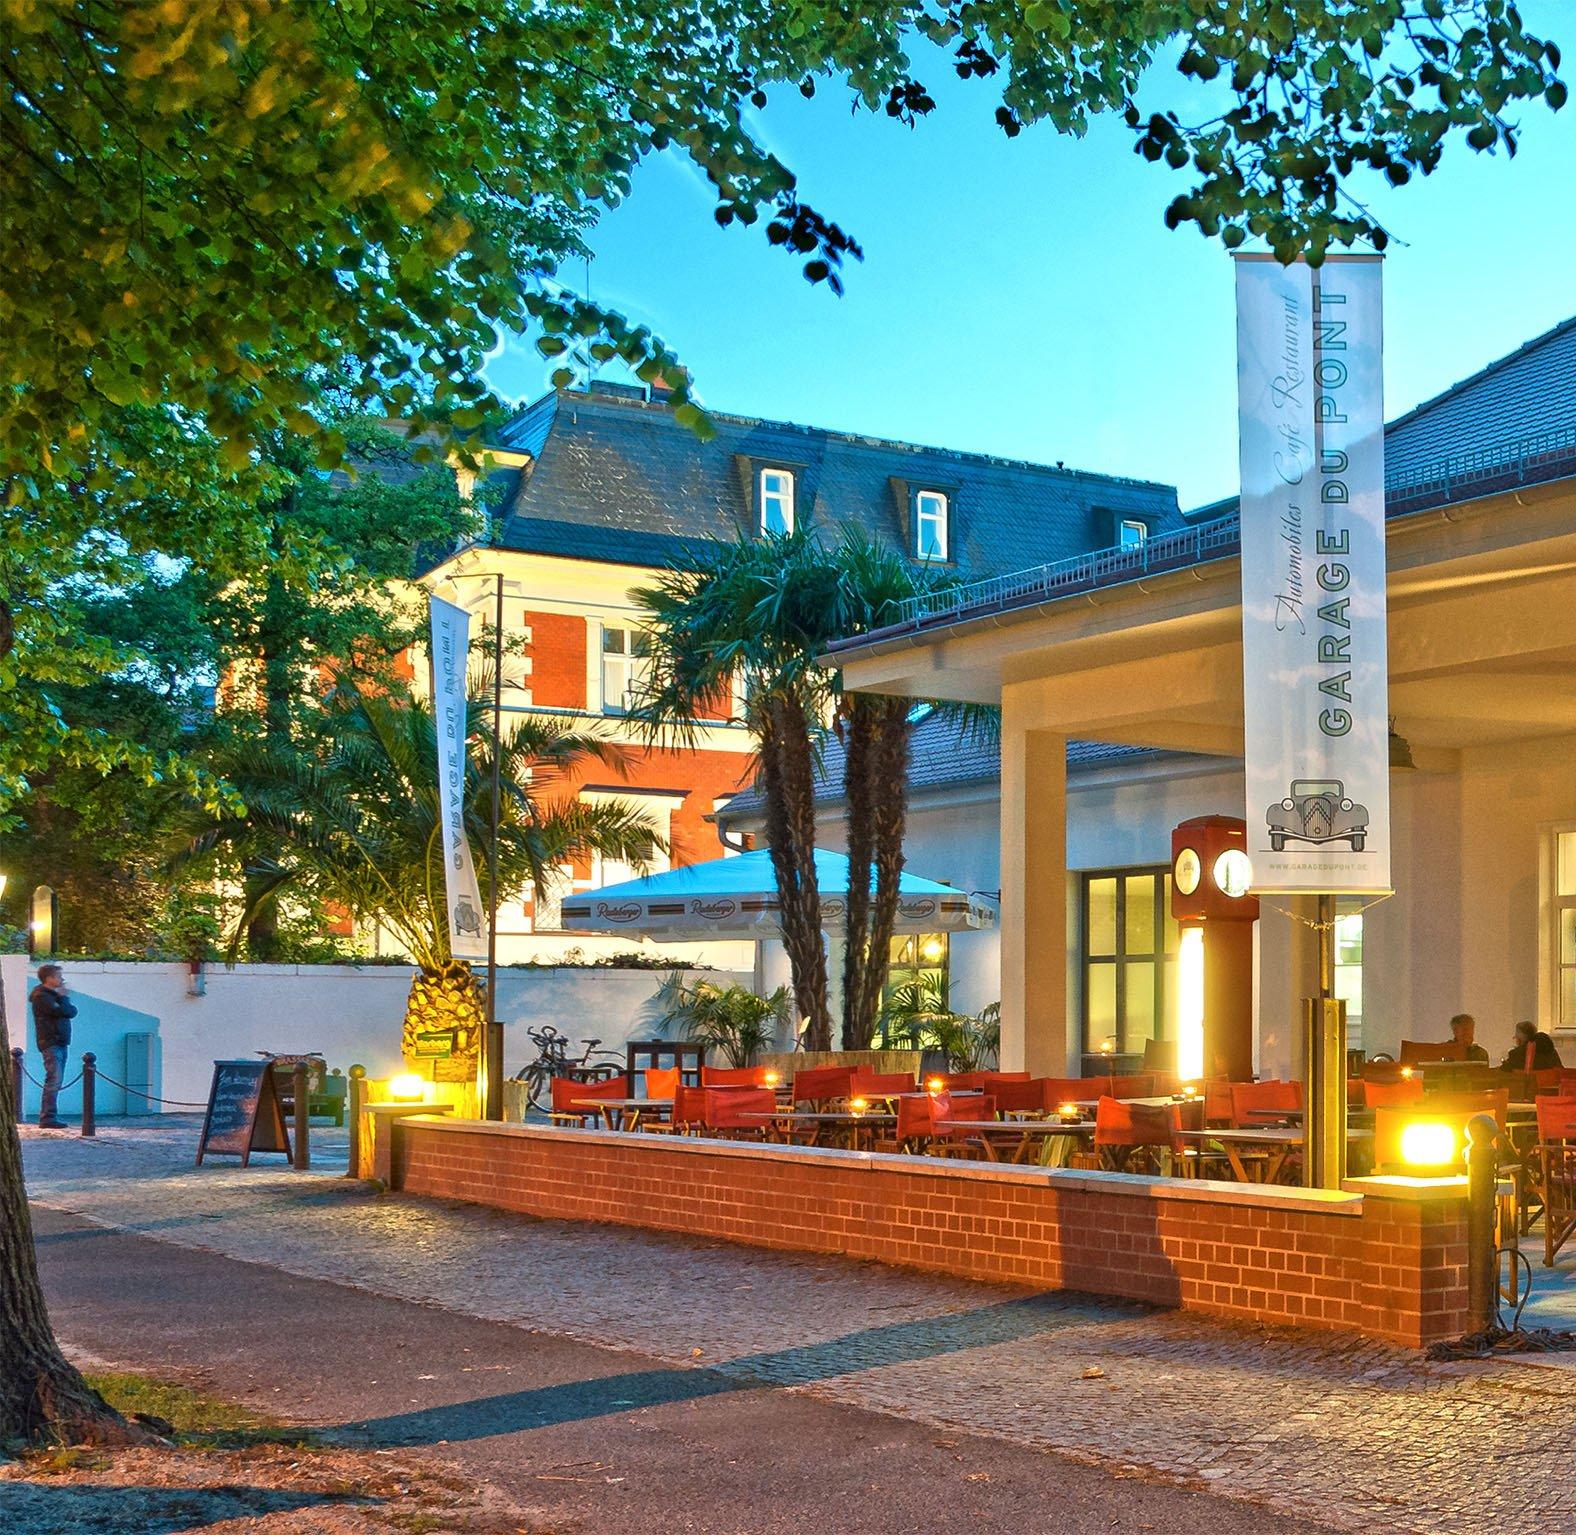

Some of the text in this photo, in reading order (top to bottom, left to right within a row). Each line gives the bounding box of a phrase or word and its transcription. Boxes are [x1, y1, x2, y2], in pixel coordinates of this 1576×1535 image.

[1270, 294, 1312, 636] Automobiles Café Restaurant
[1312, 285, 1352, 737] GARAGE DU PONT
